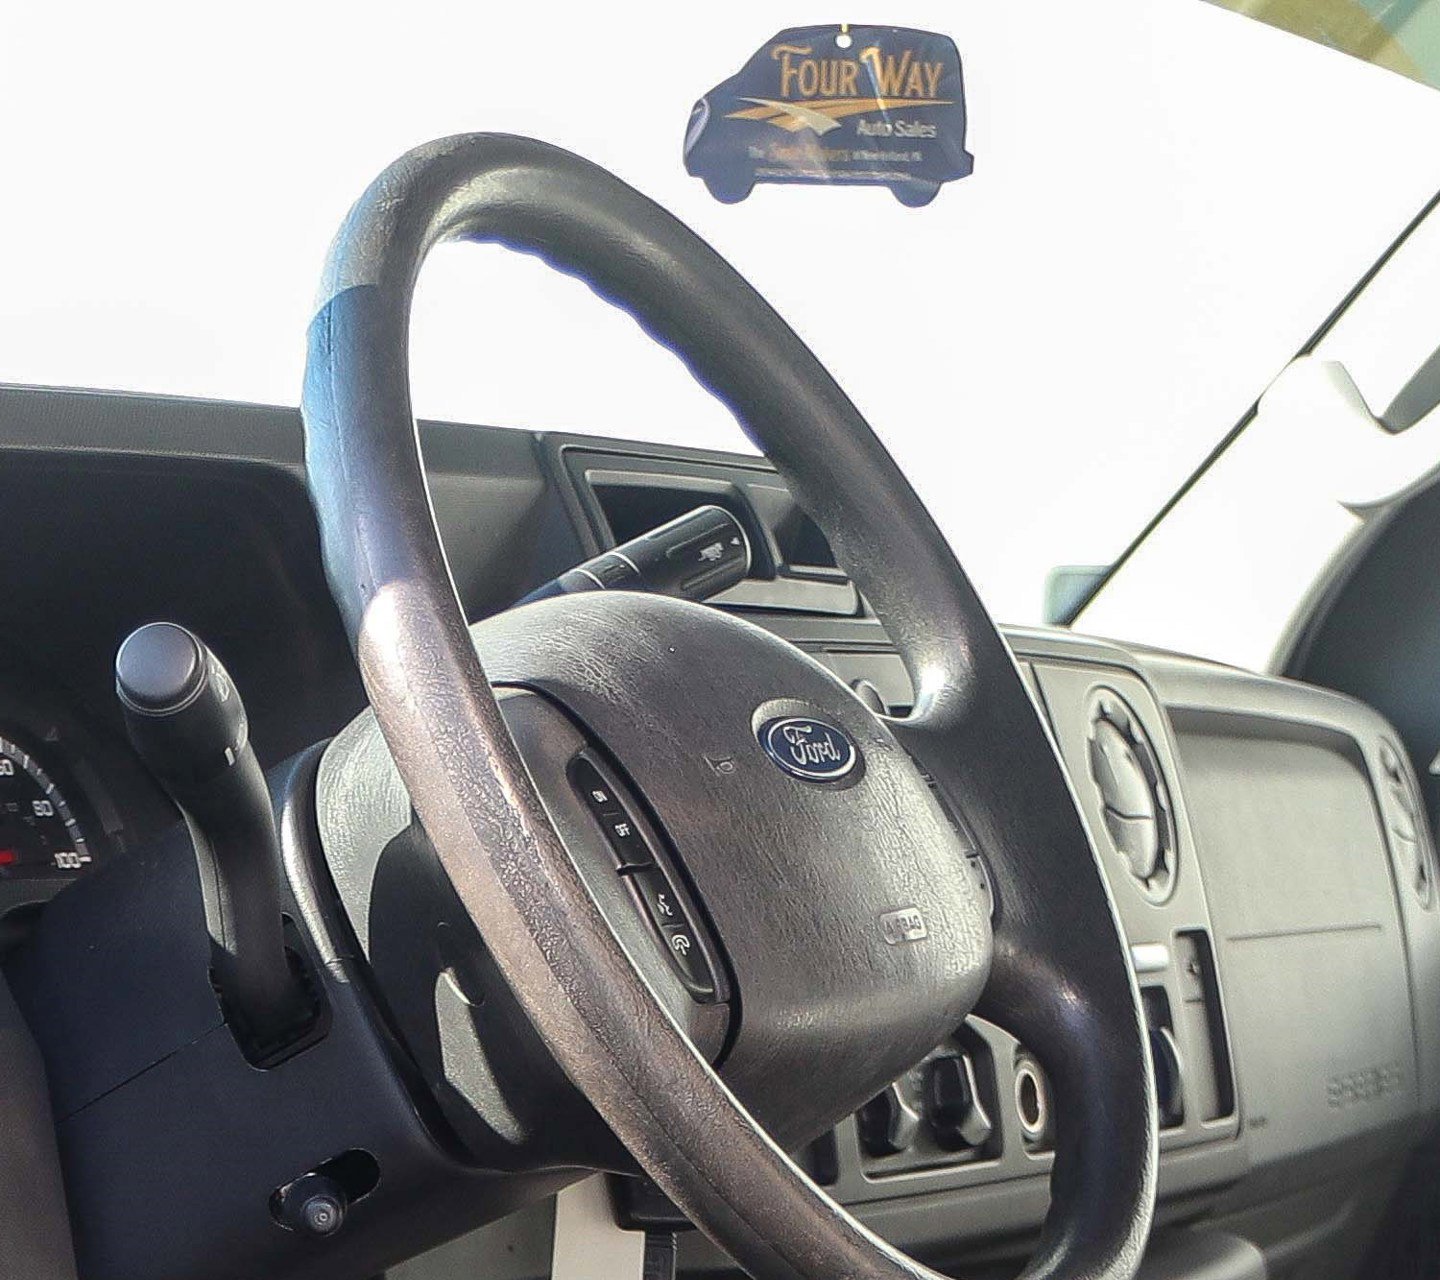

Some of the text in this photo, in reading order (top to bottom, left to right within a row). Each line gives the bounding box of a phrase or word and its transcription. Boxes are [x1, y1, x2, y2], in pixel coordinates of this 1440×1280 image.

[772, 44, 944, 97] FOUR WAY
[857, 119, 937, 138] Auto Sales
[782, 725, 841, 765] Ford
[32, 800, 54, 817] 80
[55, 852, 82, 869] 100
